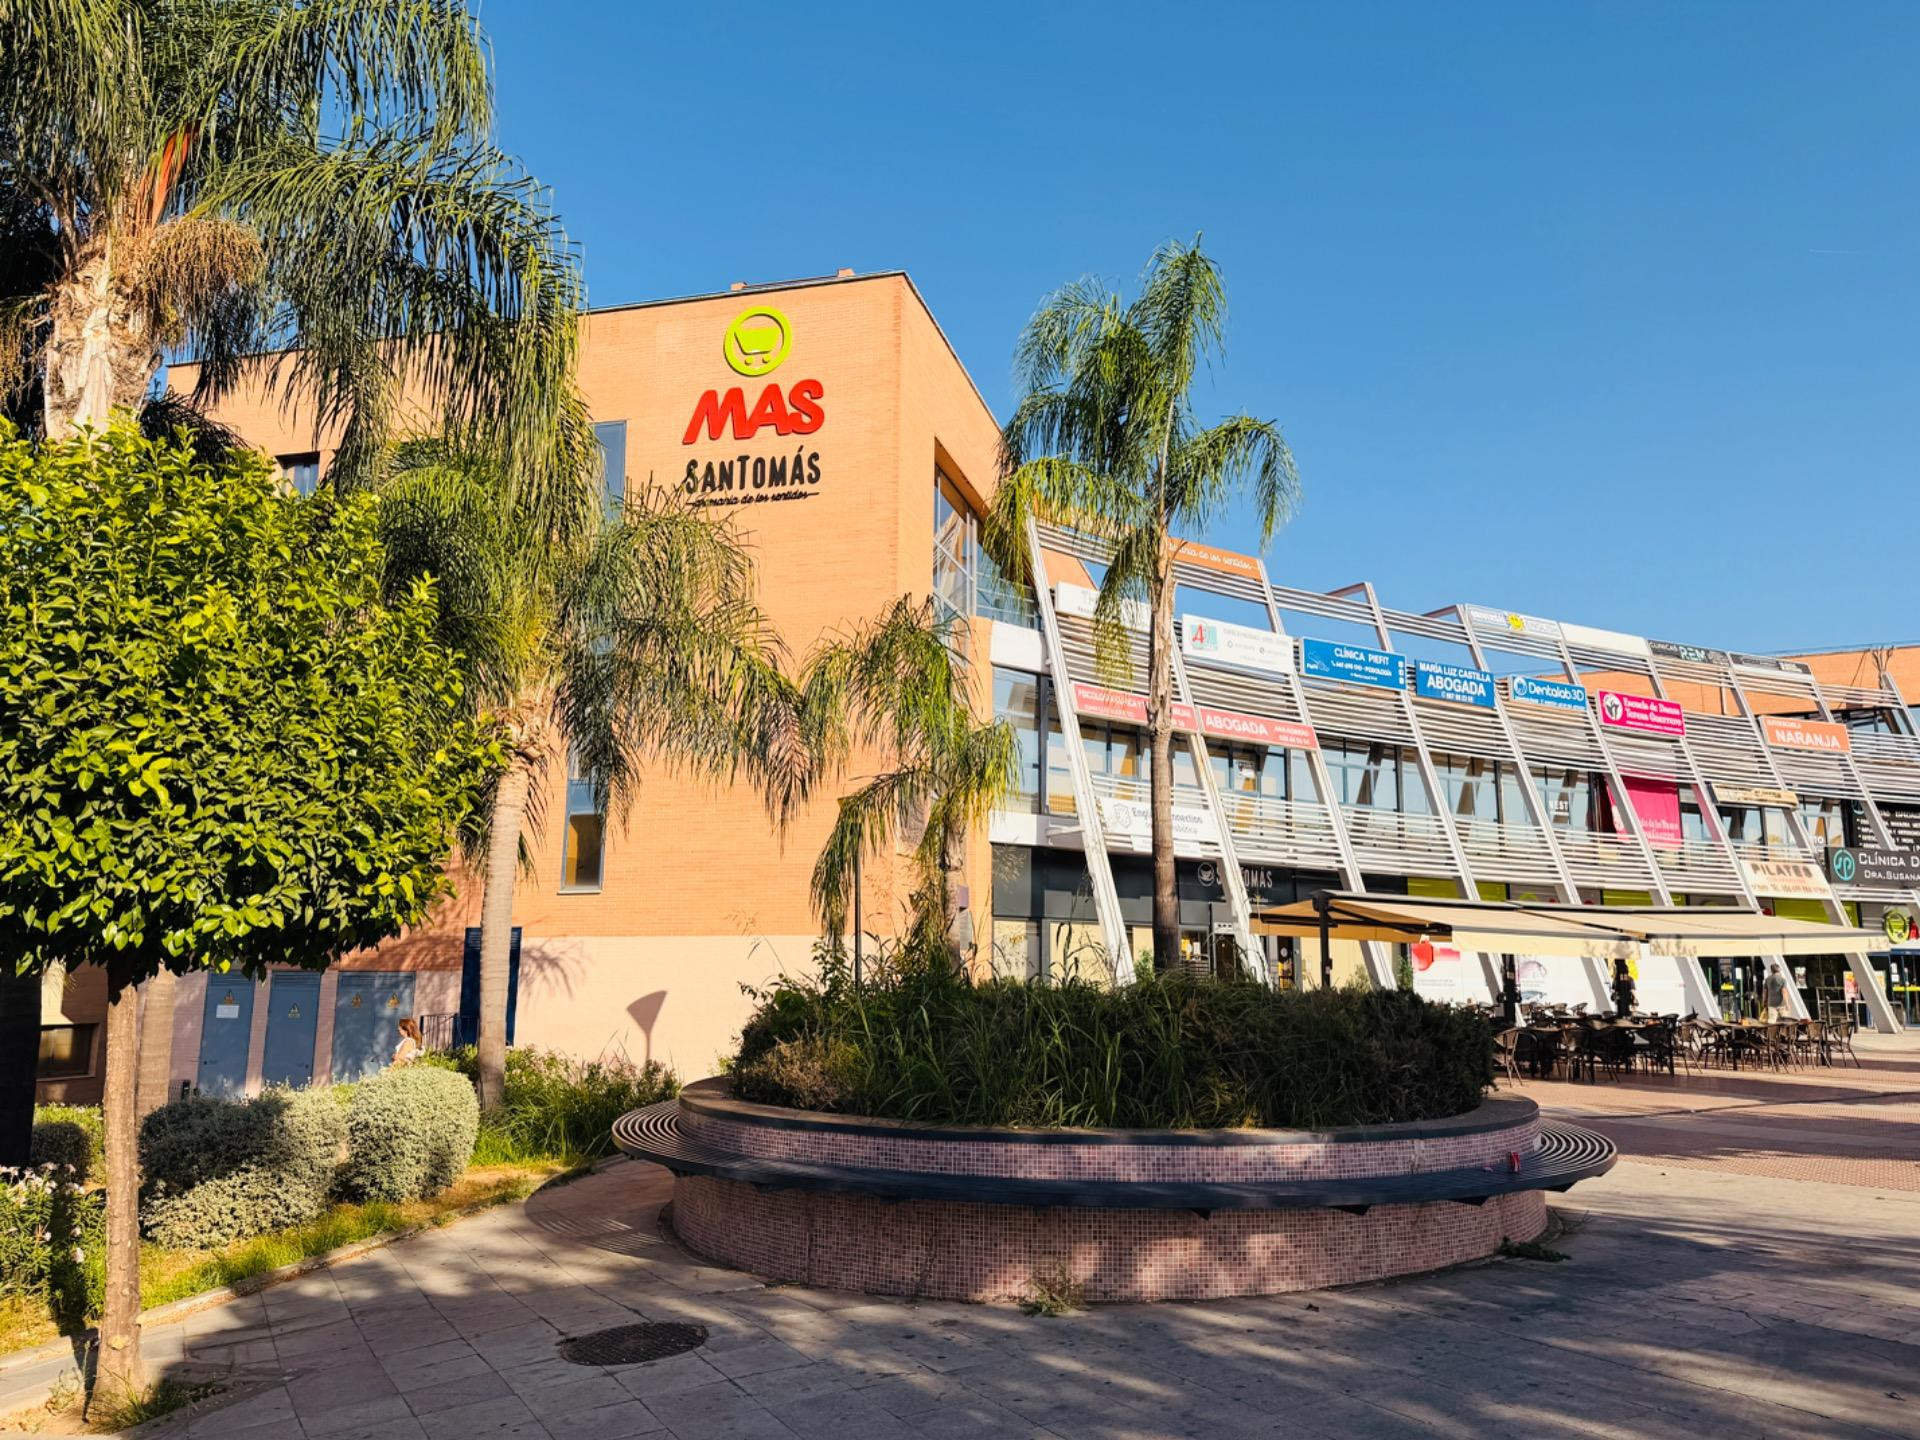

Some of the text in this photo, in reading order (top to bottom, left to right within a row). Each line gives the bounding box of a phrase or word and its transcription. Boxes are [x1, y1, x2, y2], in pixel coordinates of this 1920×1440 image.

[682, 379, 824, 445] MAS
[685, 445, 821, 494] SANTOMÁS
[1334, 646, 1365, 662] CLÍNICA
[1419, 661, 1491, 683] MARÍA LUZ CASTILLA
[1427, 674, 1486, 697] ABOGADA
[1623, 697, 1649, 710] Escuela
[1649, 701, 1658, 711] de
[1205, 714, 1268, 736] ABOGADA
[1775, 729, 1841, 749] NARANJA
[1859, 851, 1906, 867] CLÍNICA
[1751, 862, 1813, 878] PILATES
